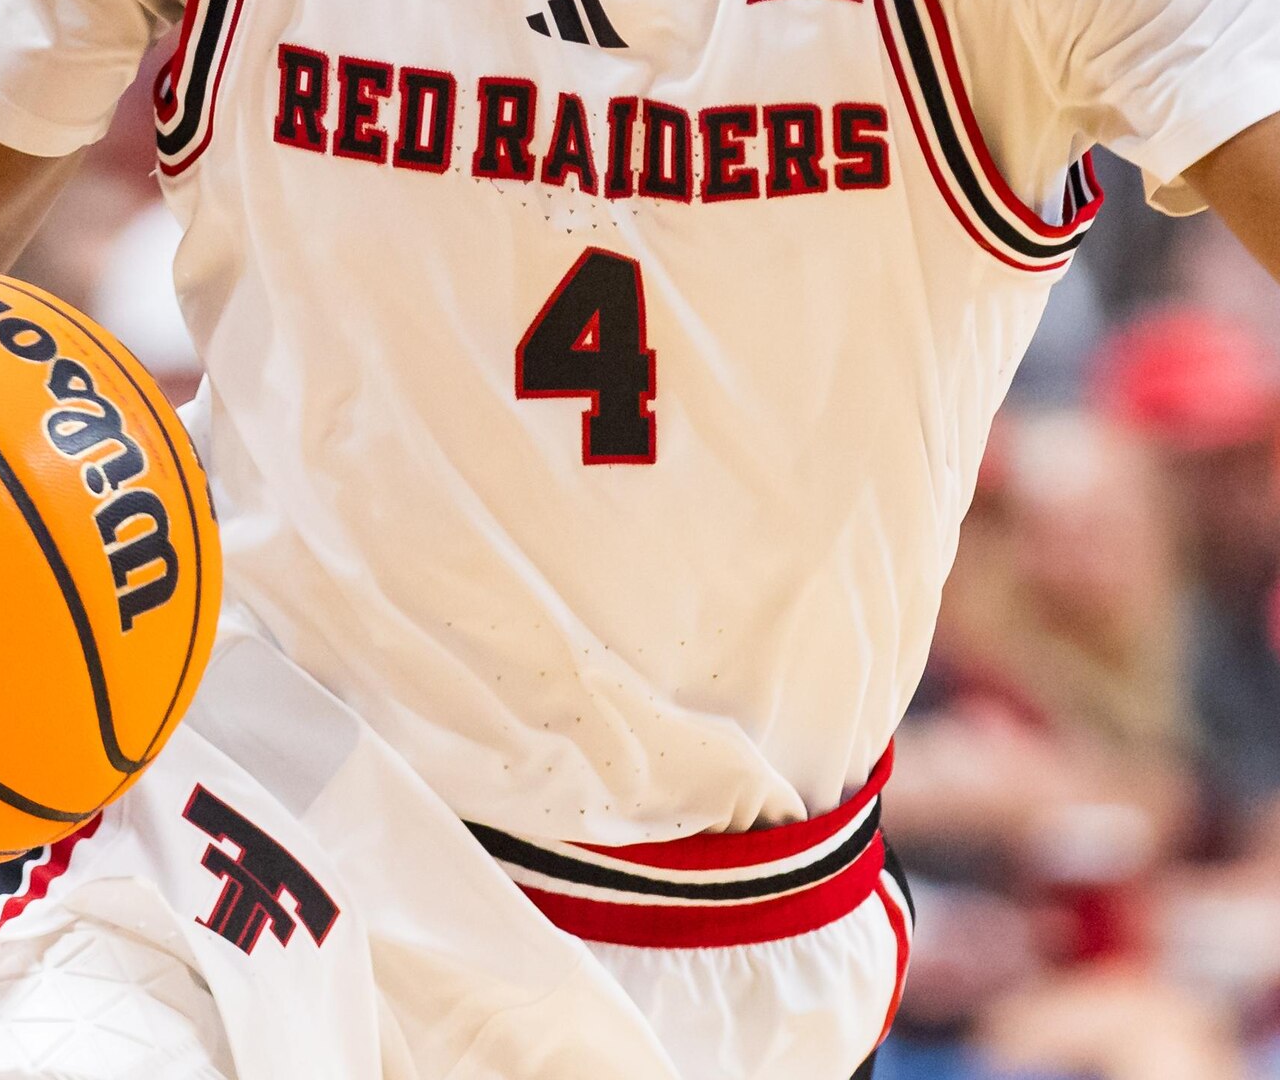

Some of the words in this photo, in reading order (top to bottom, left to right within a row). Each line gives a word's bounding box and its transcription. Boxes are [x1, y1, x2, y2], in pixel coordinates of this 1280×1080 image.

[273, 43, 457, 174] RED
[471, 76, 891, 205] RAIDERS
[515, 246, 656, 465] 4
